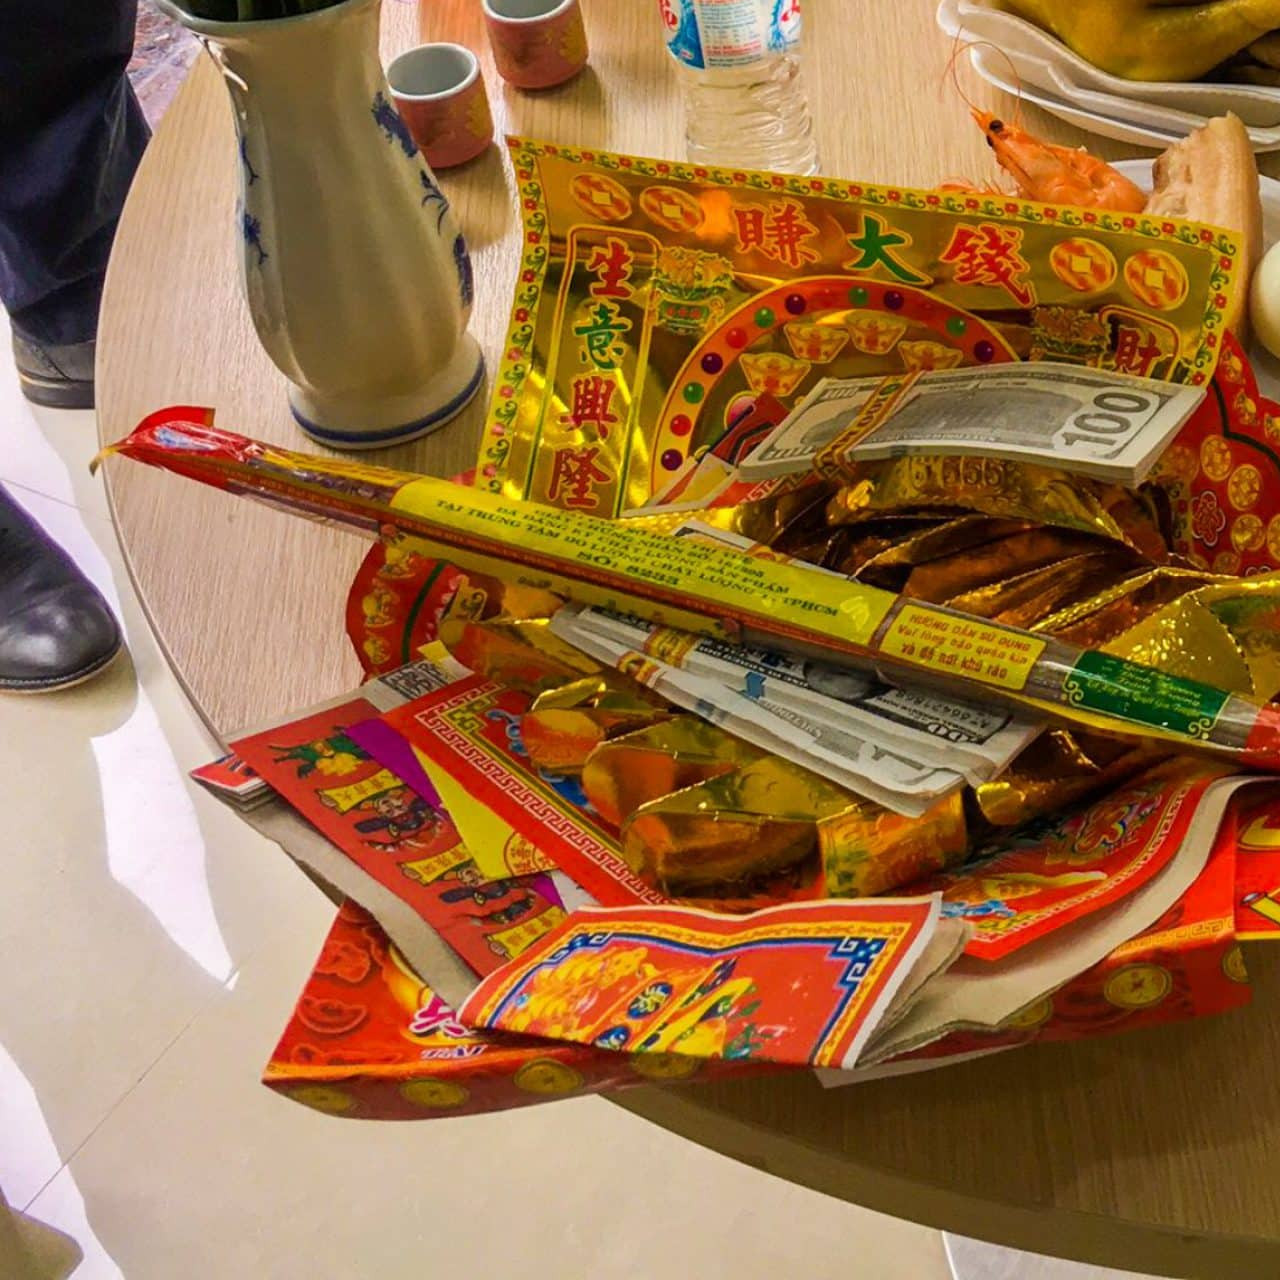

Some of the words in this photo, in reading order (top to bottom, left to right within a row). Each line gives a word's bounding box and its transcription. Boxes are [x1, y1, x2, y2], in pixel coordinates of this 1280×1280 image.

[547, 237, 635, 509] 生意興隆
[1062, 389, 1153, 448] 100
